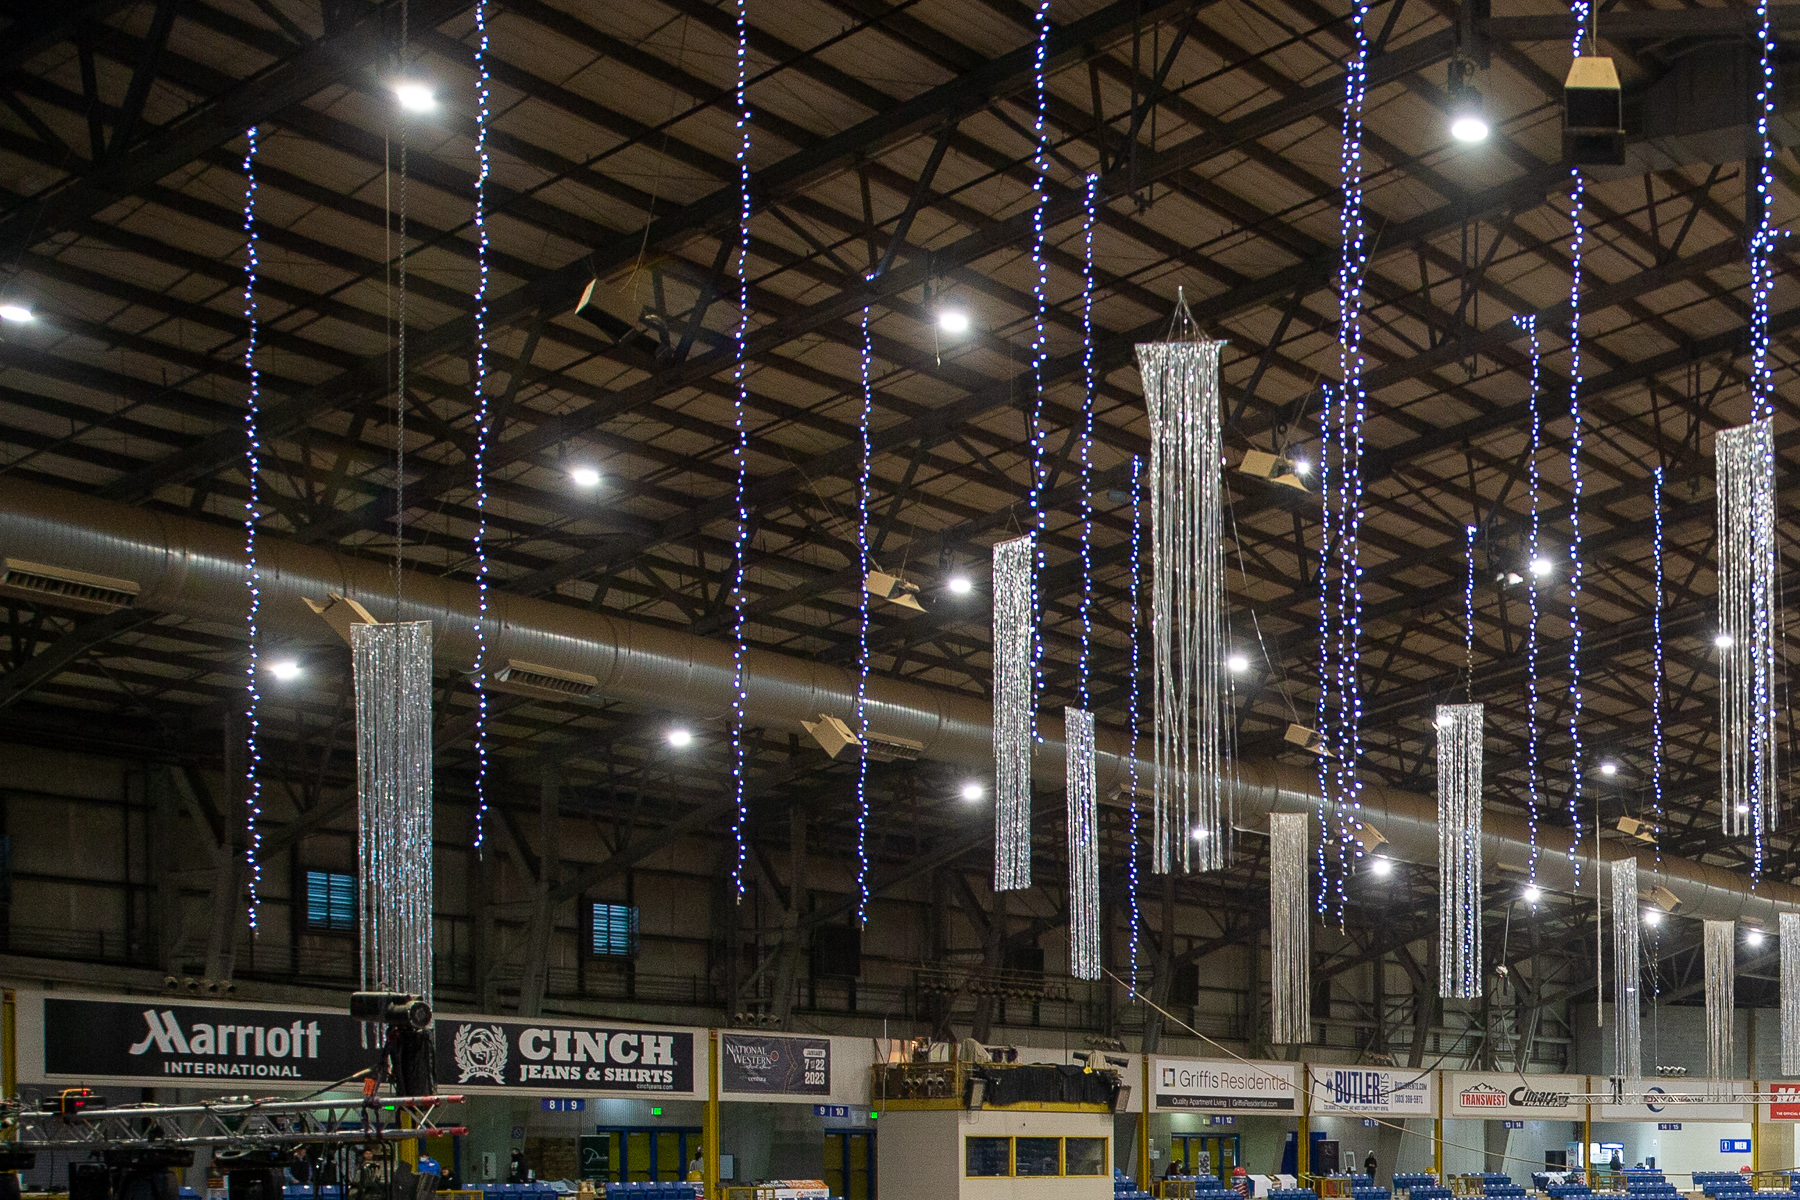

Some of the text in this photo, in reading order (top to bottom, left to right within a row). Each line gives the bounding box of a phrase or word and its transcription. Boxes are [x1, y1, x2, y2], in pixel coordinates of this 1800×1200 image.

[128, 1009, 321, 1058] Marriott
[518, 1028, 674, 1066] CINCH
[726, 1044, 767, 1056] NATIONAL
[732, 1054, 772, 1065] WESTERN
[804, 1059, 809, 1071] 7
[815, 1059, 825, 1071] 22
[164, 1061, 302, 1077] INTERNATIONAL
[519, 1064, 673, 1084] JEANS & SHIRTS
[804, 1072, 825, 1085] 2023
[1335, 1070, 1381, 1105] BUTLER
[1381, 1072, 1389, 1105] RENTS
[549, 1100, 577, 1110] 8 9
[1172, 1097, 1189, 1107] Quality
[1189, 1098, 1213, 1107] Apartment
[1213, 1098, 1227, 1108] Living
[1461, 1094, 1506, 1106] TRANSWEST
[820, 1106, 844, 1116] 9 10
[1226, 1115, 1232, 1124] 12
[1734, 1141, 1748, 1150] MEN
